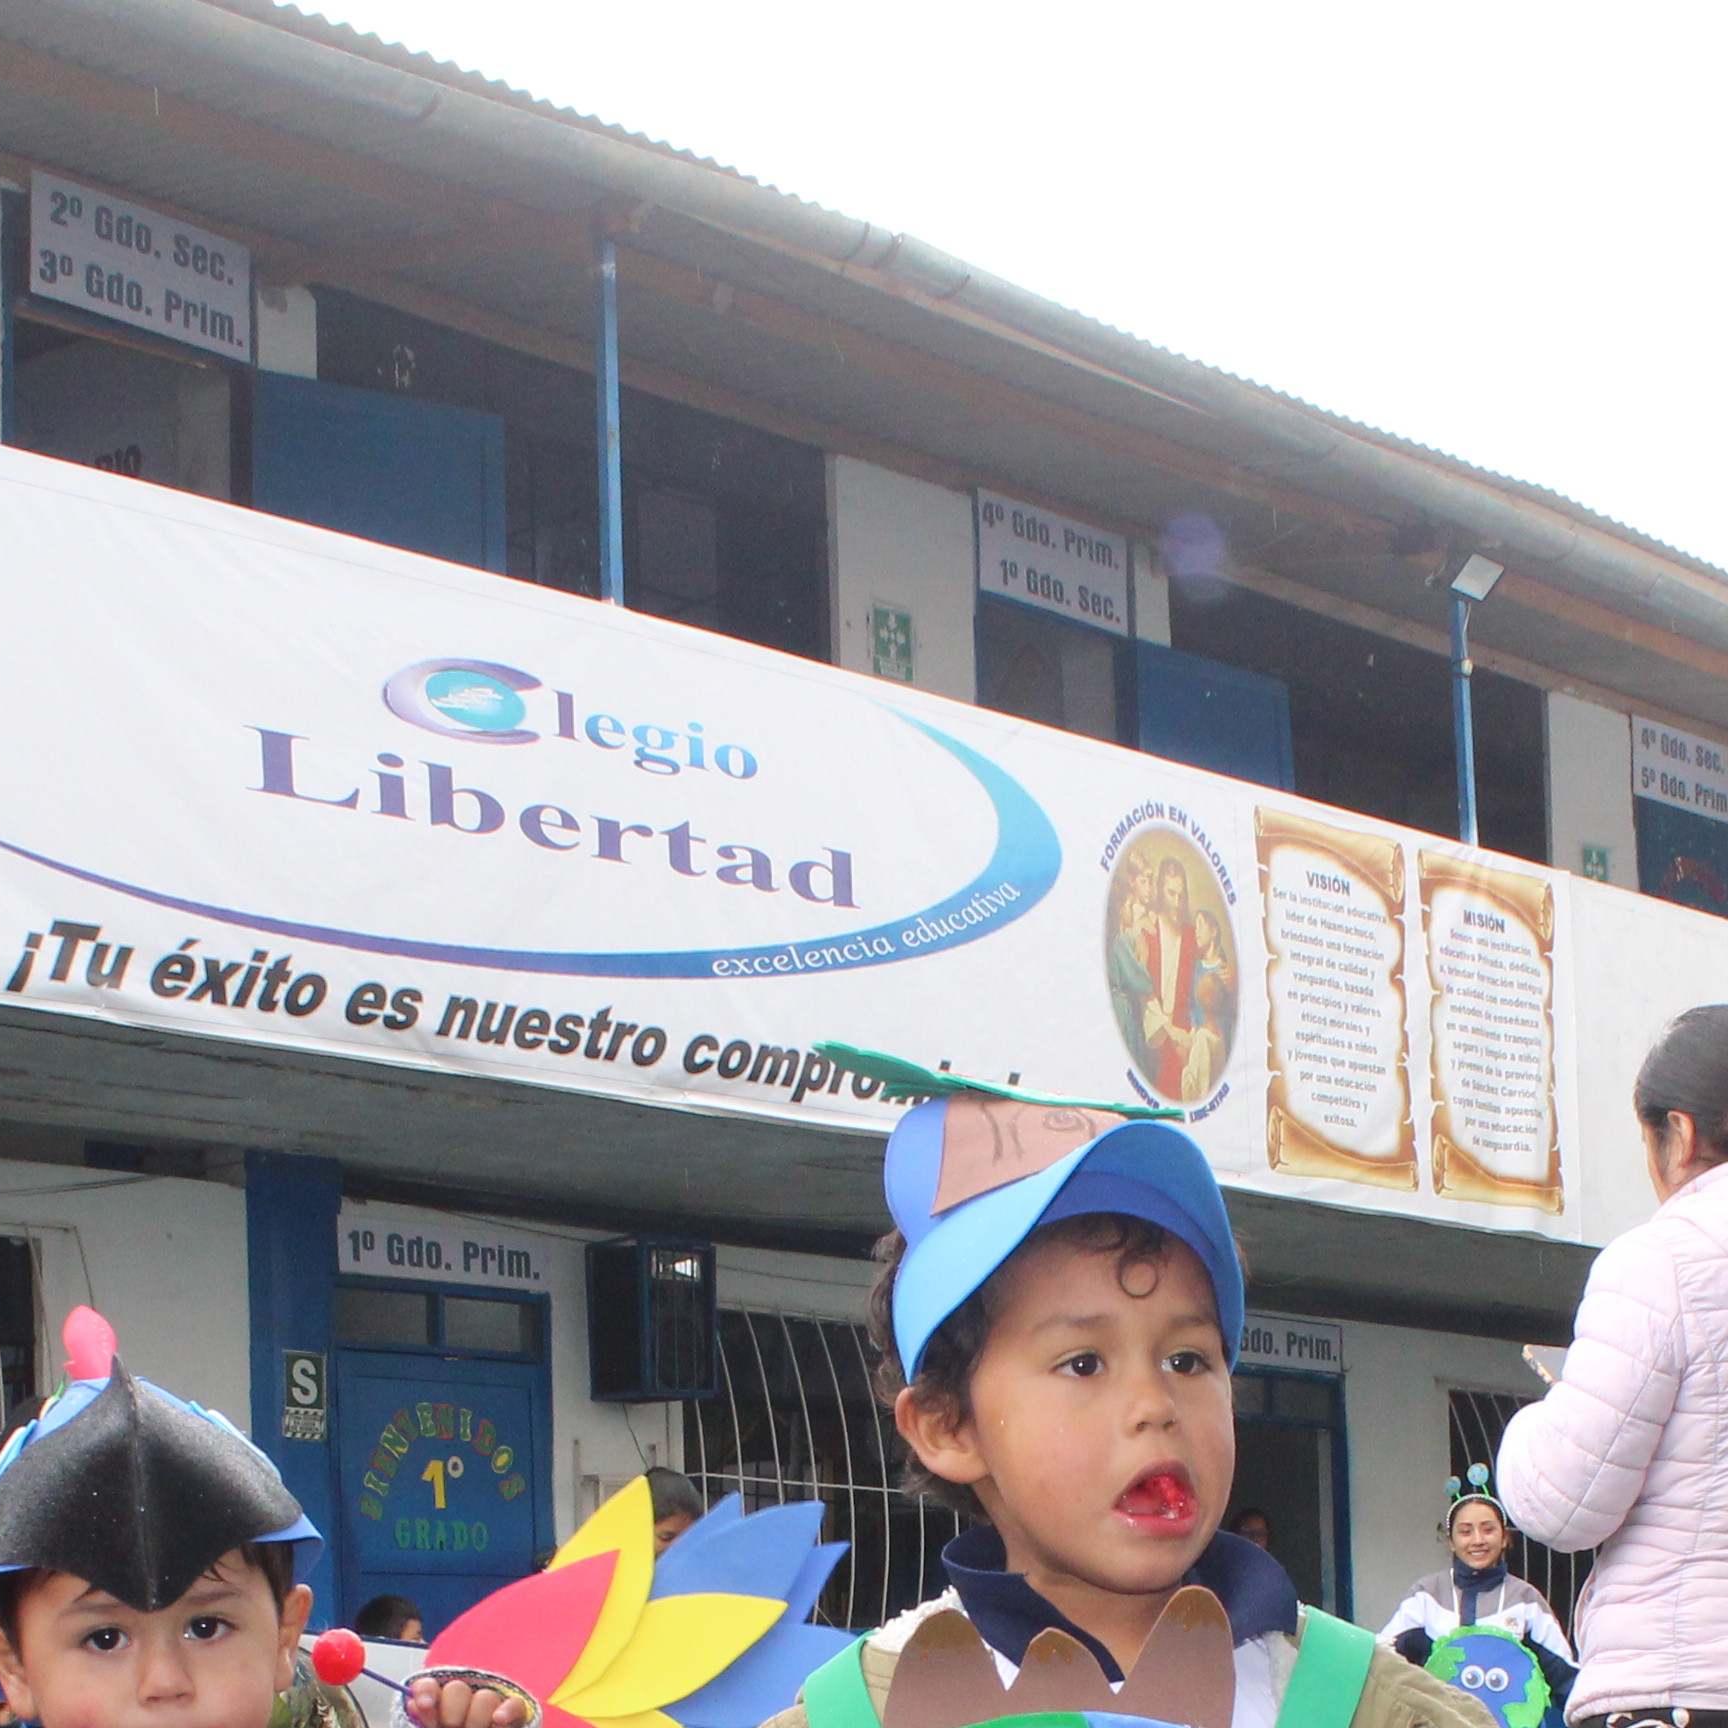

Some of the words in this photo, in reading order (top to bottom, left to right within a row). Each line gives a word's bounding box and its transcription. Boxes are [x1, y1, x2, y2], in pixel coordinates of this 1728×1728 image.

[94, 206, 161, 259] Gdo.
[173, 233, 235, 286] Sec.
[85, 263, 152, 316] Gdo.
[164, 289, 244, 347] Prim.
[1012, 510, 1057, 549] Gdo.
[1063, 529, 1119, 569] Prim.
[1026, 567, 1071, 606] Gdo.
[1078, 584, 1121, 623] Sec.
[245, 725, 861, 909] Libertad
[1100, 800, 1165, 872] FORMACIÓN
[1169, 806, 1187, 825] EN
[1190, 821, 1237, 907] VALORES
[1304, 870, 1351, 897] VISIÓN
[712, 936, 896, 977] excelencia
[901, 881, 1021, 949] educativa
[1463, 909, 1505, 934] MISIÓN
[5, 920, 134, 993] ¡Tu
[150, 939, 327, 1017] éxito
[344, 981, 423, 1030] es
[436, 993, 668, 1067] nuestro
[386, 1232, 453, 1272] Gdo.
[463, 1241, 540, 1281] Prim.
[1286, 1331, 1338, 1362] Prim.
[292, 1358, 319, 1405] S
[359, 1401, 527, 1522] BIENVENIDOS
[394, 1517, 490, 1552] GRADO
